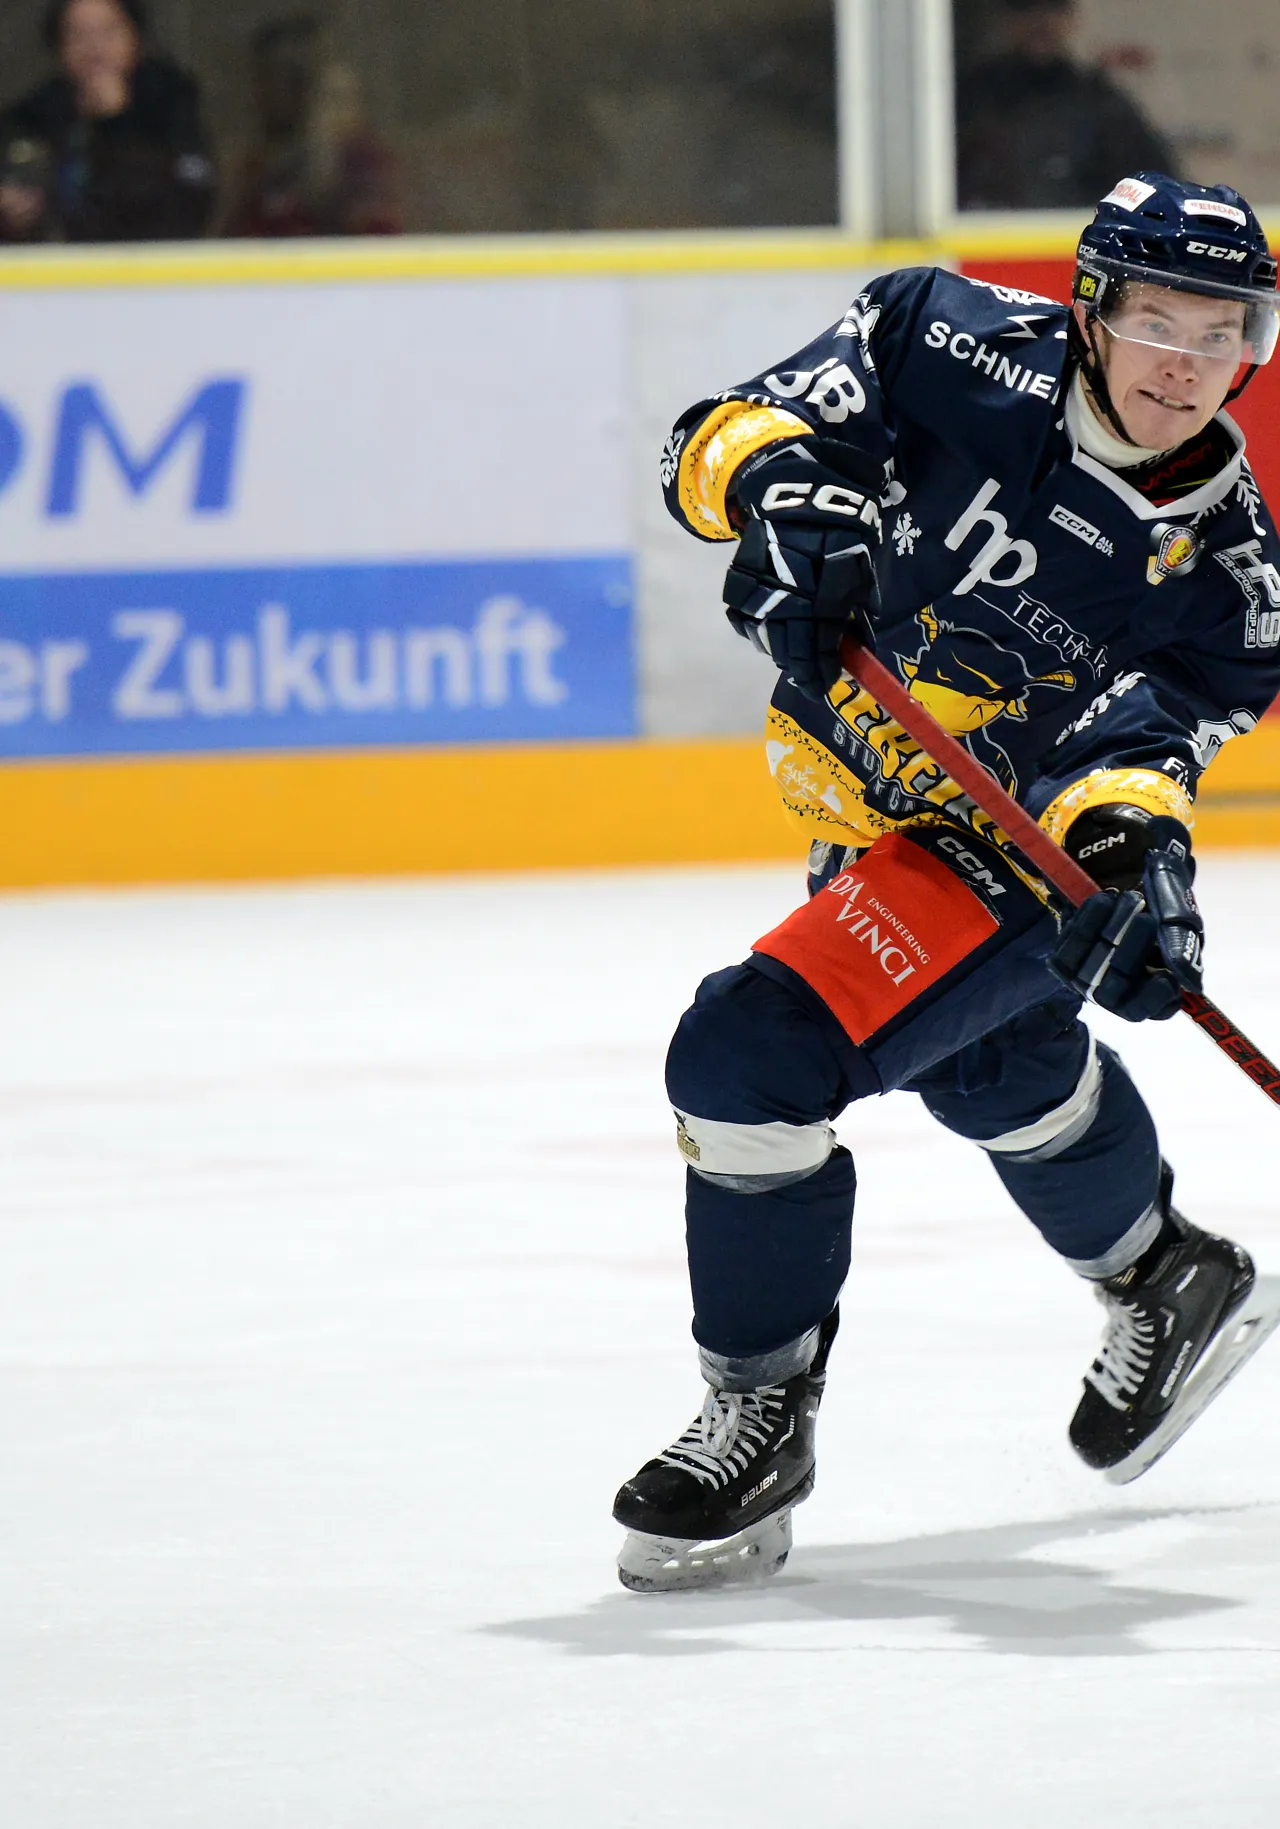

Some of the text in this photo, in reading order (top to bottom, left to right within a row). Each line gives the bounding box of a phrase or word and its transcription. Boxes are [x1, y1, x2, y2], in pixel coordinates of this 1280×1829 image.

[1187, 241, 1247, 263] CCM
[944, 478, 1038, 595] hp
[1054, 510, 1095, 539] CCM
[1098, 536, 1114, 550] ALL
[112, 597, 567, 720] Zukunft
[1078, 832, 1126, 859] CCM
[937, 836, 1007, 897] CCM
[828, 874, 865, 903] DA
[836, 901, 917, 988] VINCI
[867, 897, 931, 965] ENGINEERING
[741, 1470, 778, 1507] BAUER
